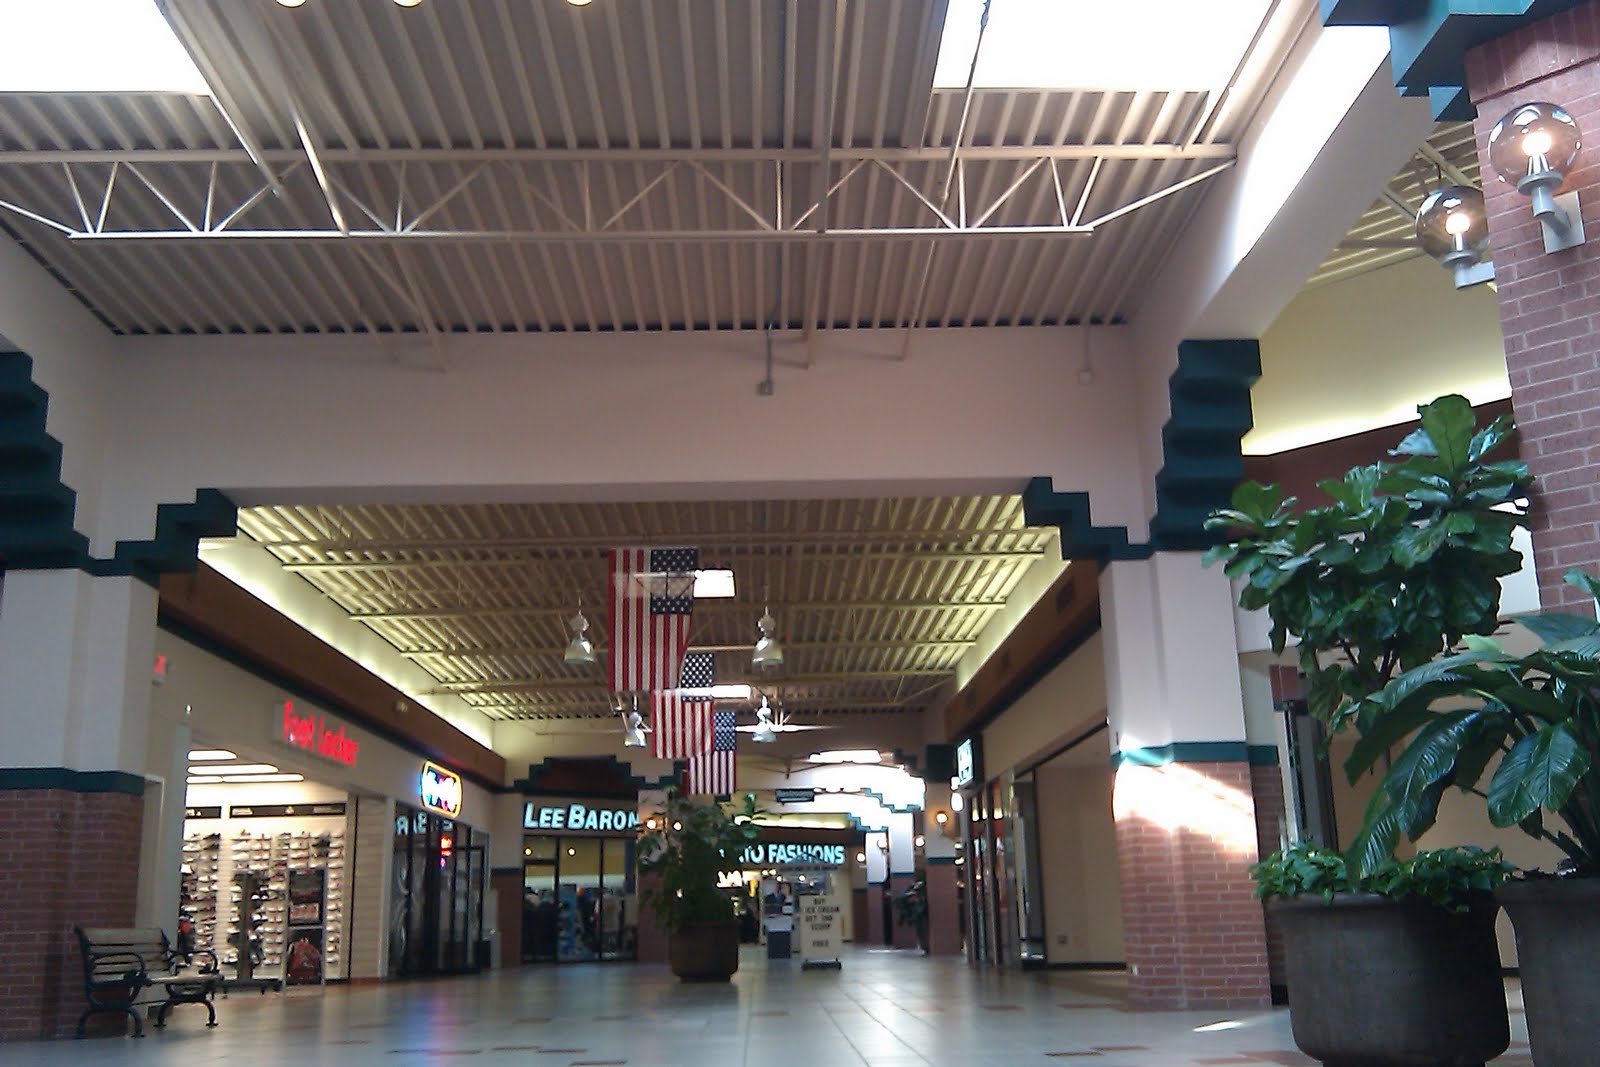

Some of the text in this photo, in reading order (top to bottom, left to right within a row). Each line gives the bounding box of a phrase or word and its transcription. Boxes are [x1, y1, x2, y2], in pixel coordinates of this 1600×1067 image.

[283, 699, 358, 768] Foot Locker
[523, 802, 639, 831] LEE BARON
[769, 843, 846, 865] FASHIONS
